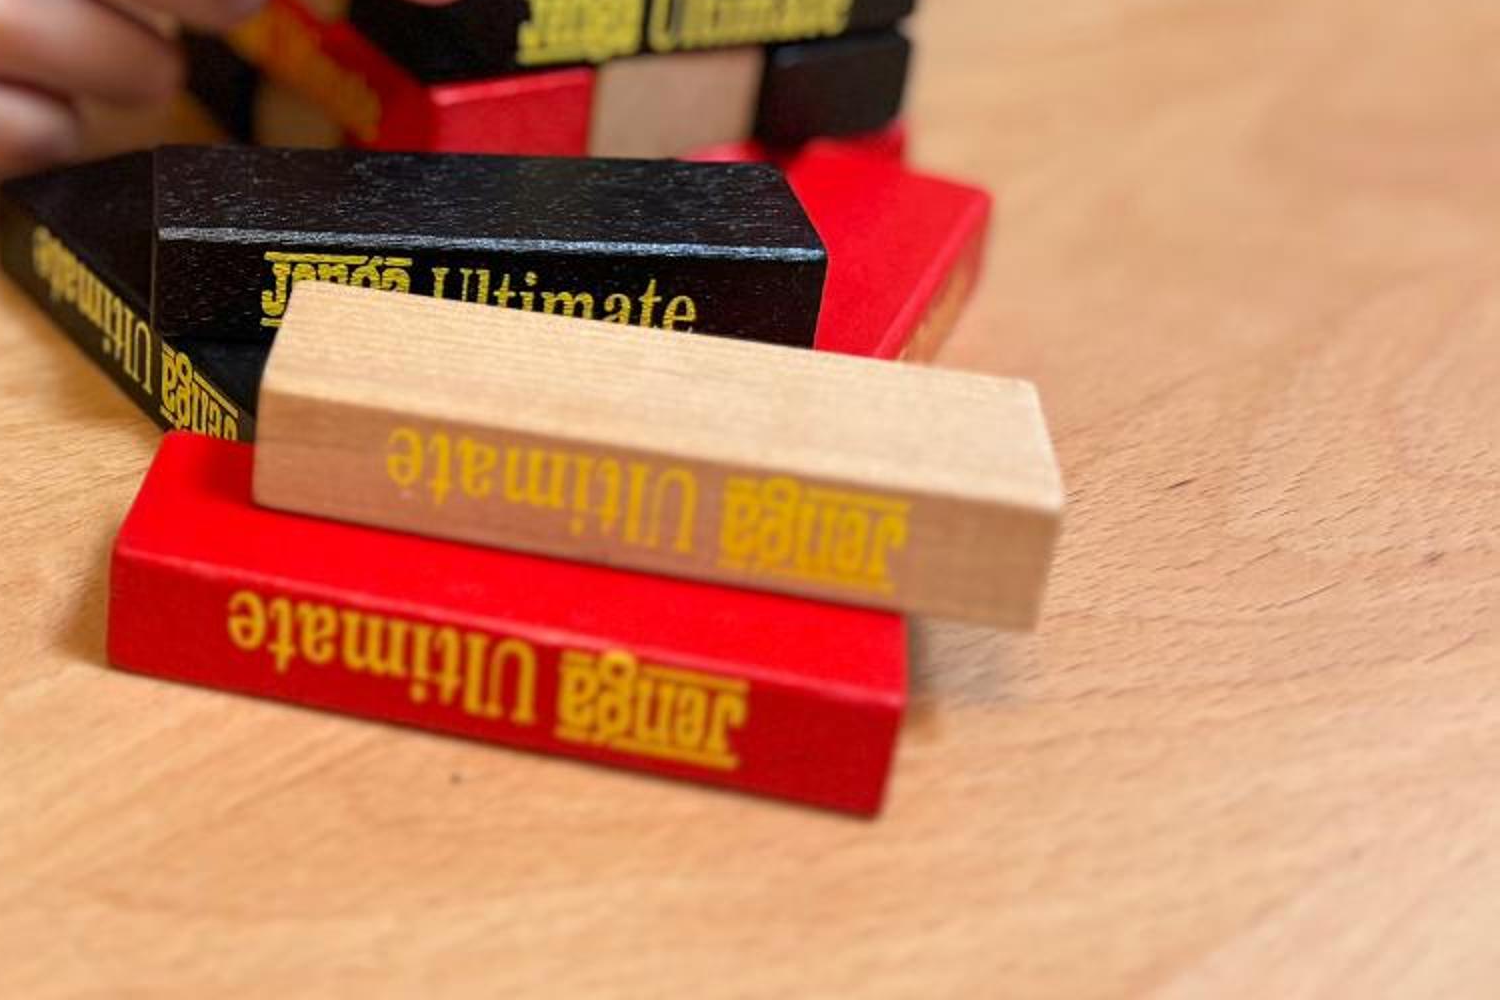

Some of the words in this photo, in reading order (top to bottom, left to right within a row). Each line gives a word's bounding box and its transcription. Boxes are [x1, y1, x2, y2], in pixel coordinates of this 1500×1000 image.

[386, 426, 698, 554] Ultimate
[716, 476, 912, 596] Jenga
[228, 590, 538, 726] Ultimate
[553, 650, 750, 771] Jenga
